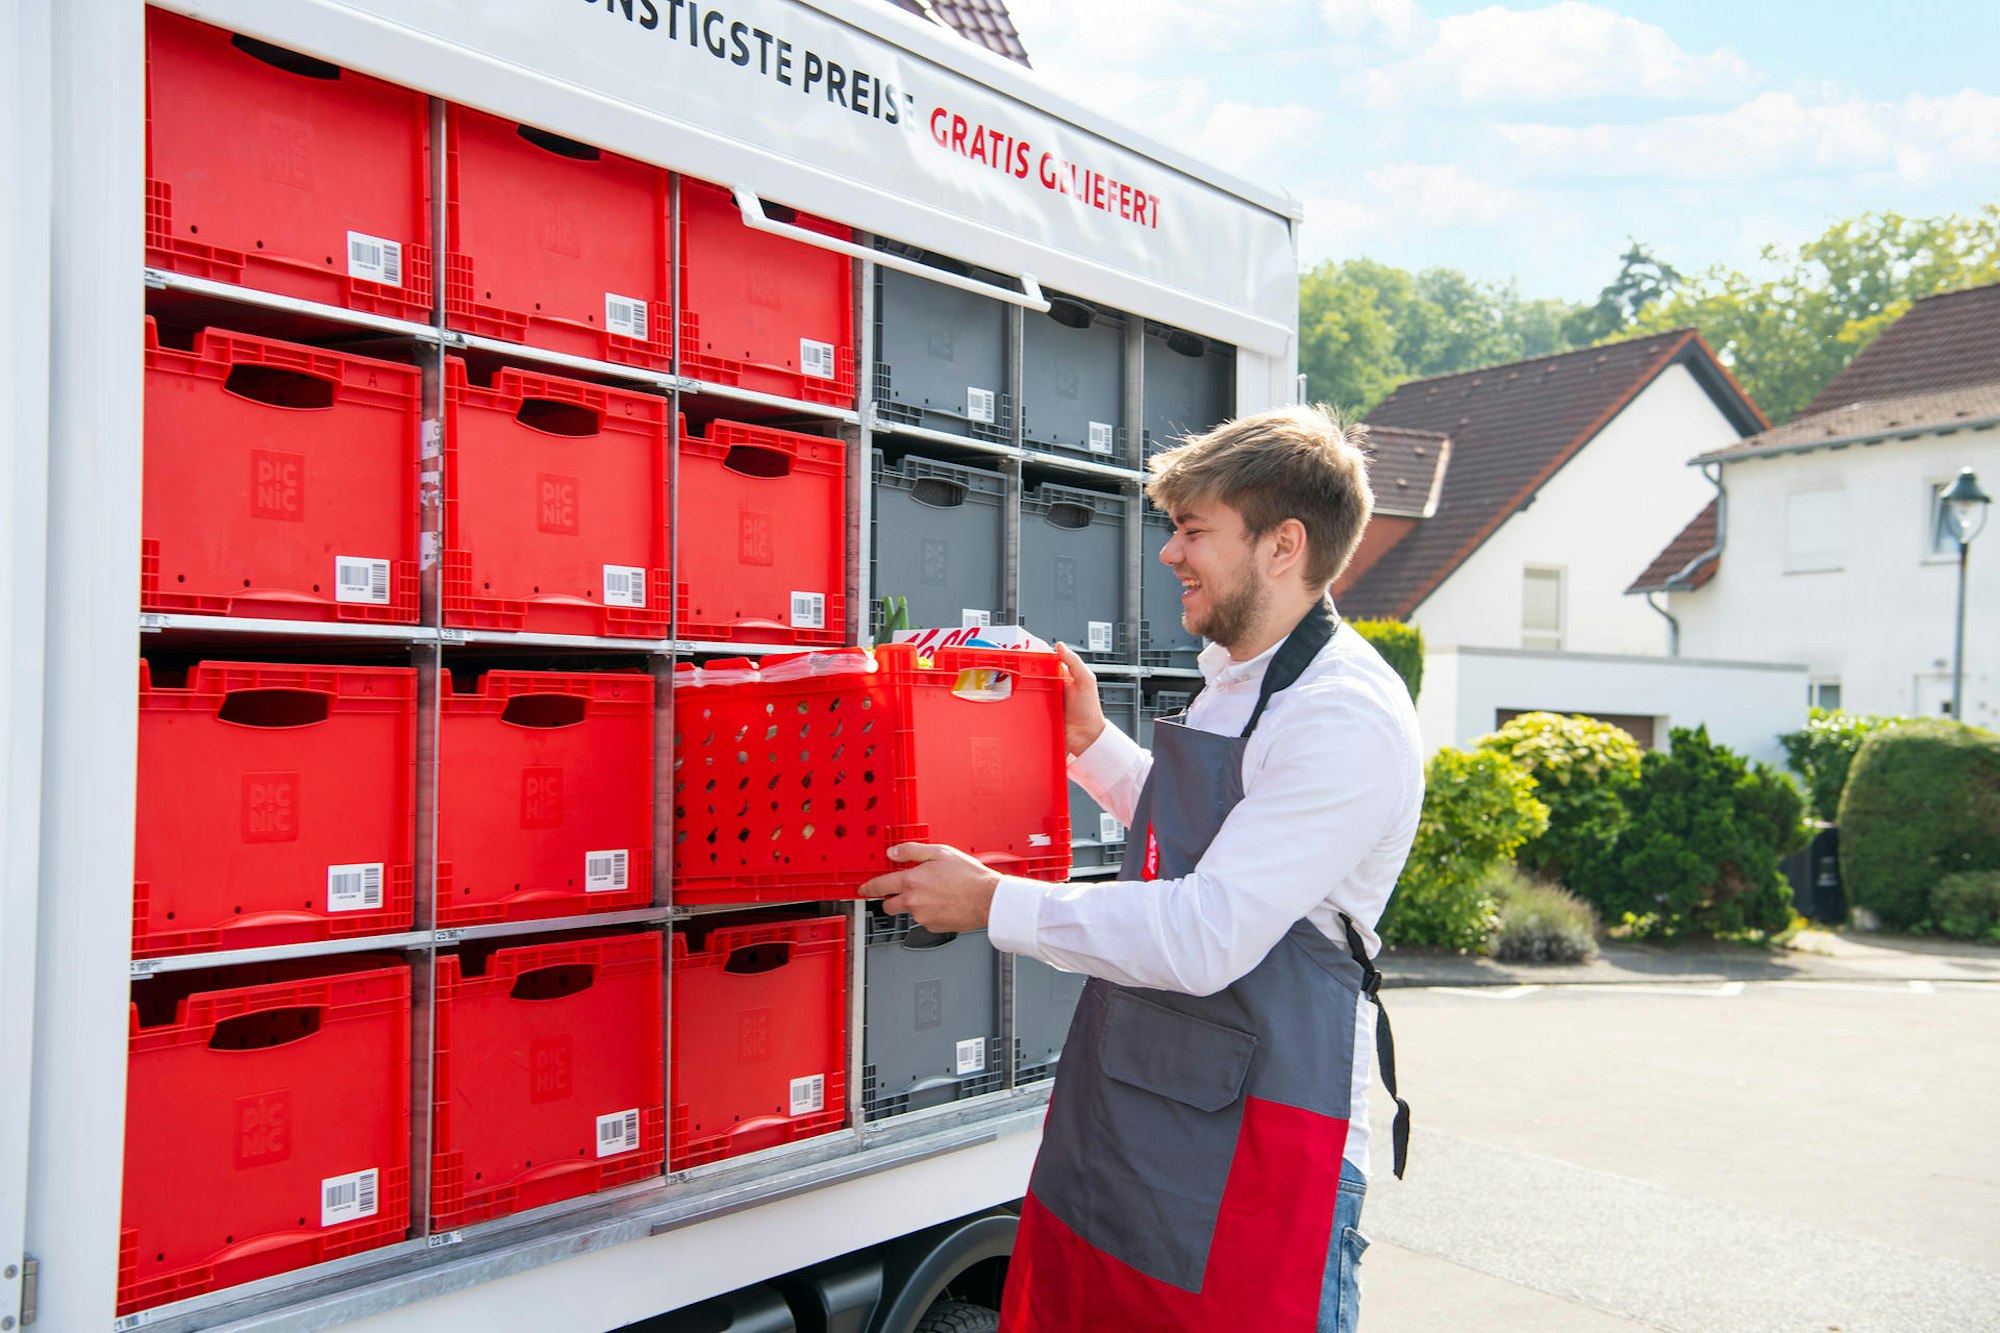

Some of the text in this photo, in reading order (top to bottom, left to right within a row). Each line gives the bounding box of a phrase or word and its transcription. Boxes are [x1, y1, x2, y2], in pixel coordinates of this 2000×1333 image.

[930, 107, 1031, 179] GRATIS
[1039, 152, 1161, 229] GELIEFERT
[258, 458, 298, 487] PIC
[543, 480, 573, 505] PIC
[249, 783, 291, 807] PIC
[431, 1235, 442, 1247] 22
